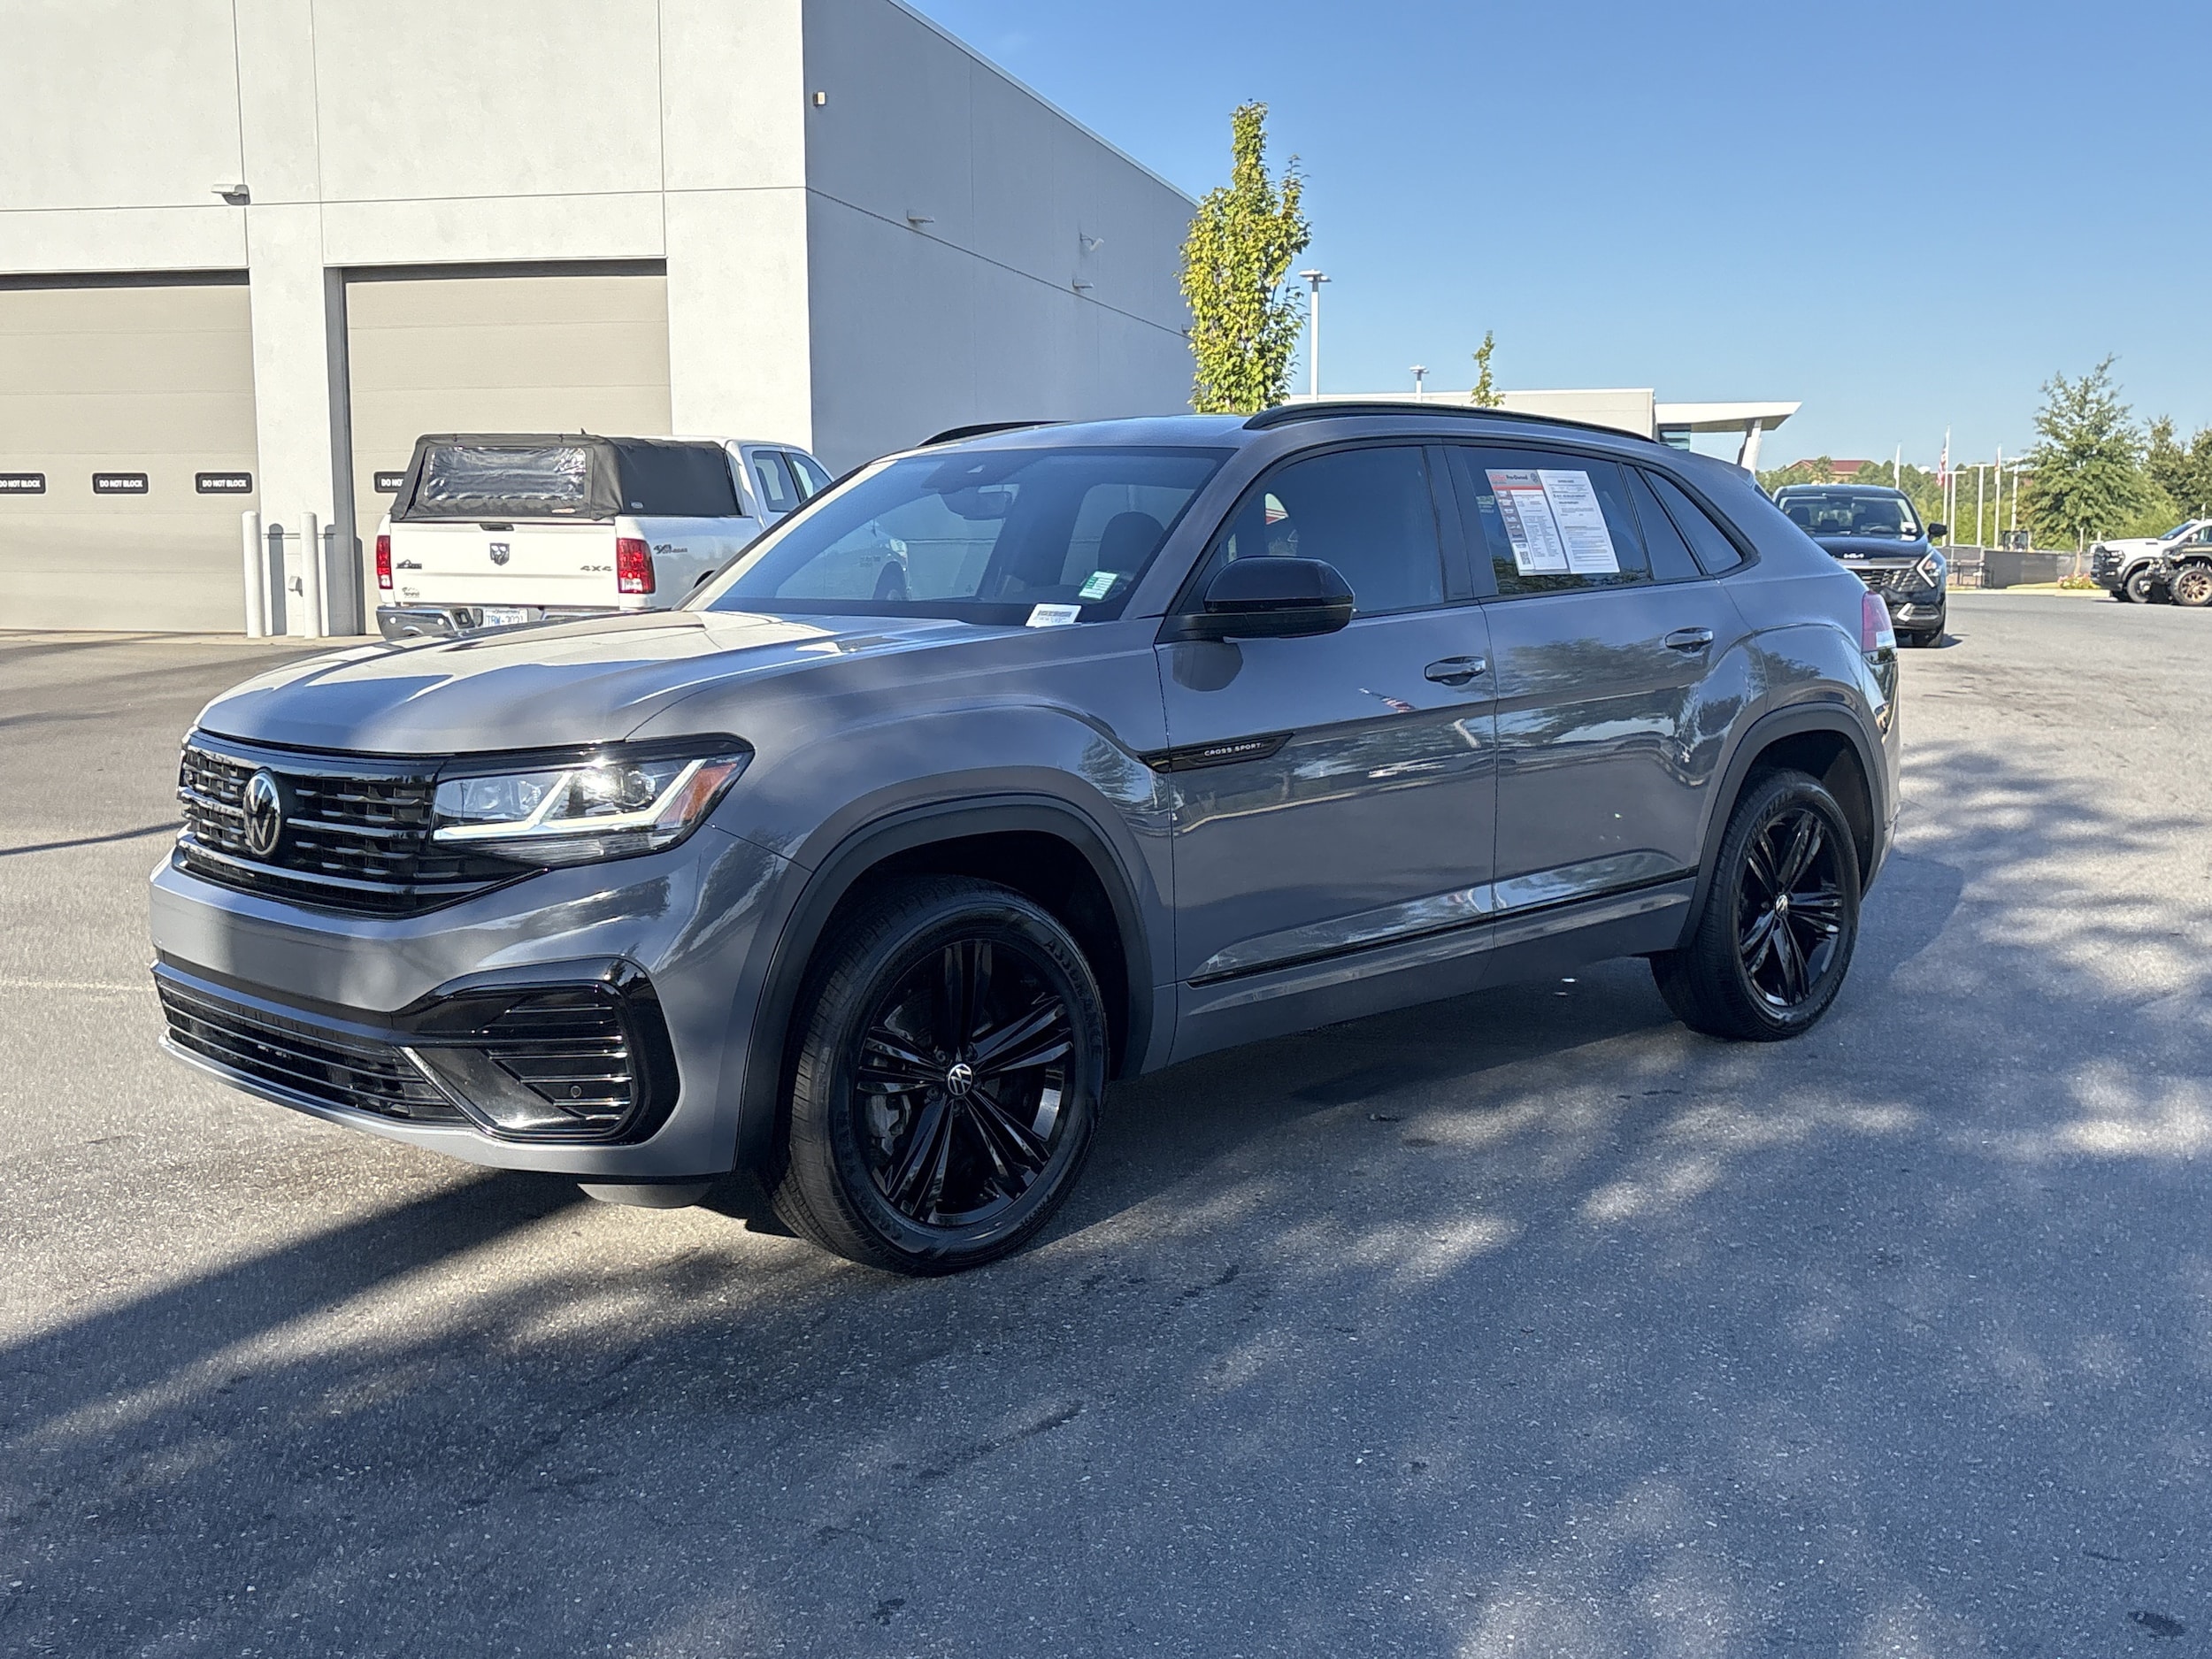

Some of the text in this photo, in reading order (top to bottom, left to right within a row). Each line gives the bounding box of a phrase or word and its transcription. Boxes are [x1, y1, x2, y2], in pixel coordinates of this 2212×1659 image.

[380, 478, 391, 487] DO
[1204, 742, 1262, 757] CROSS SPORT
